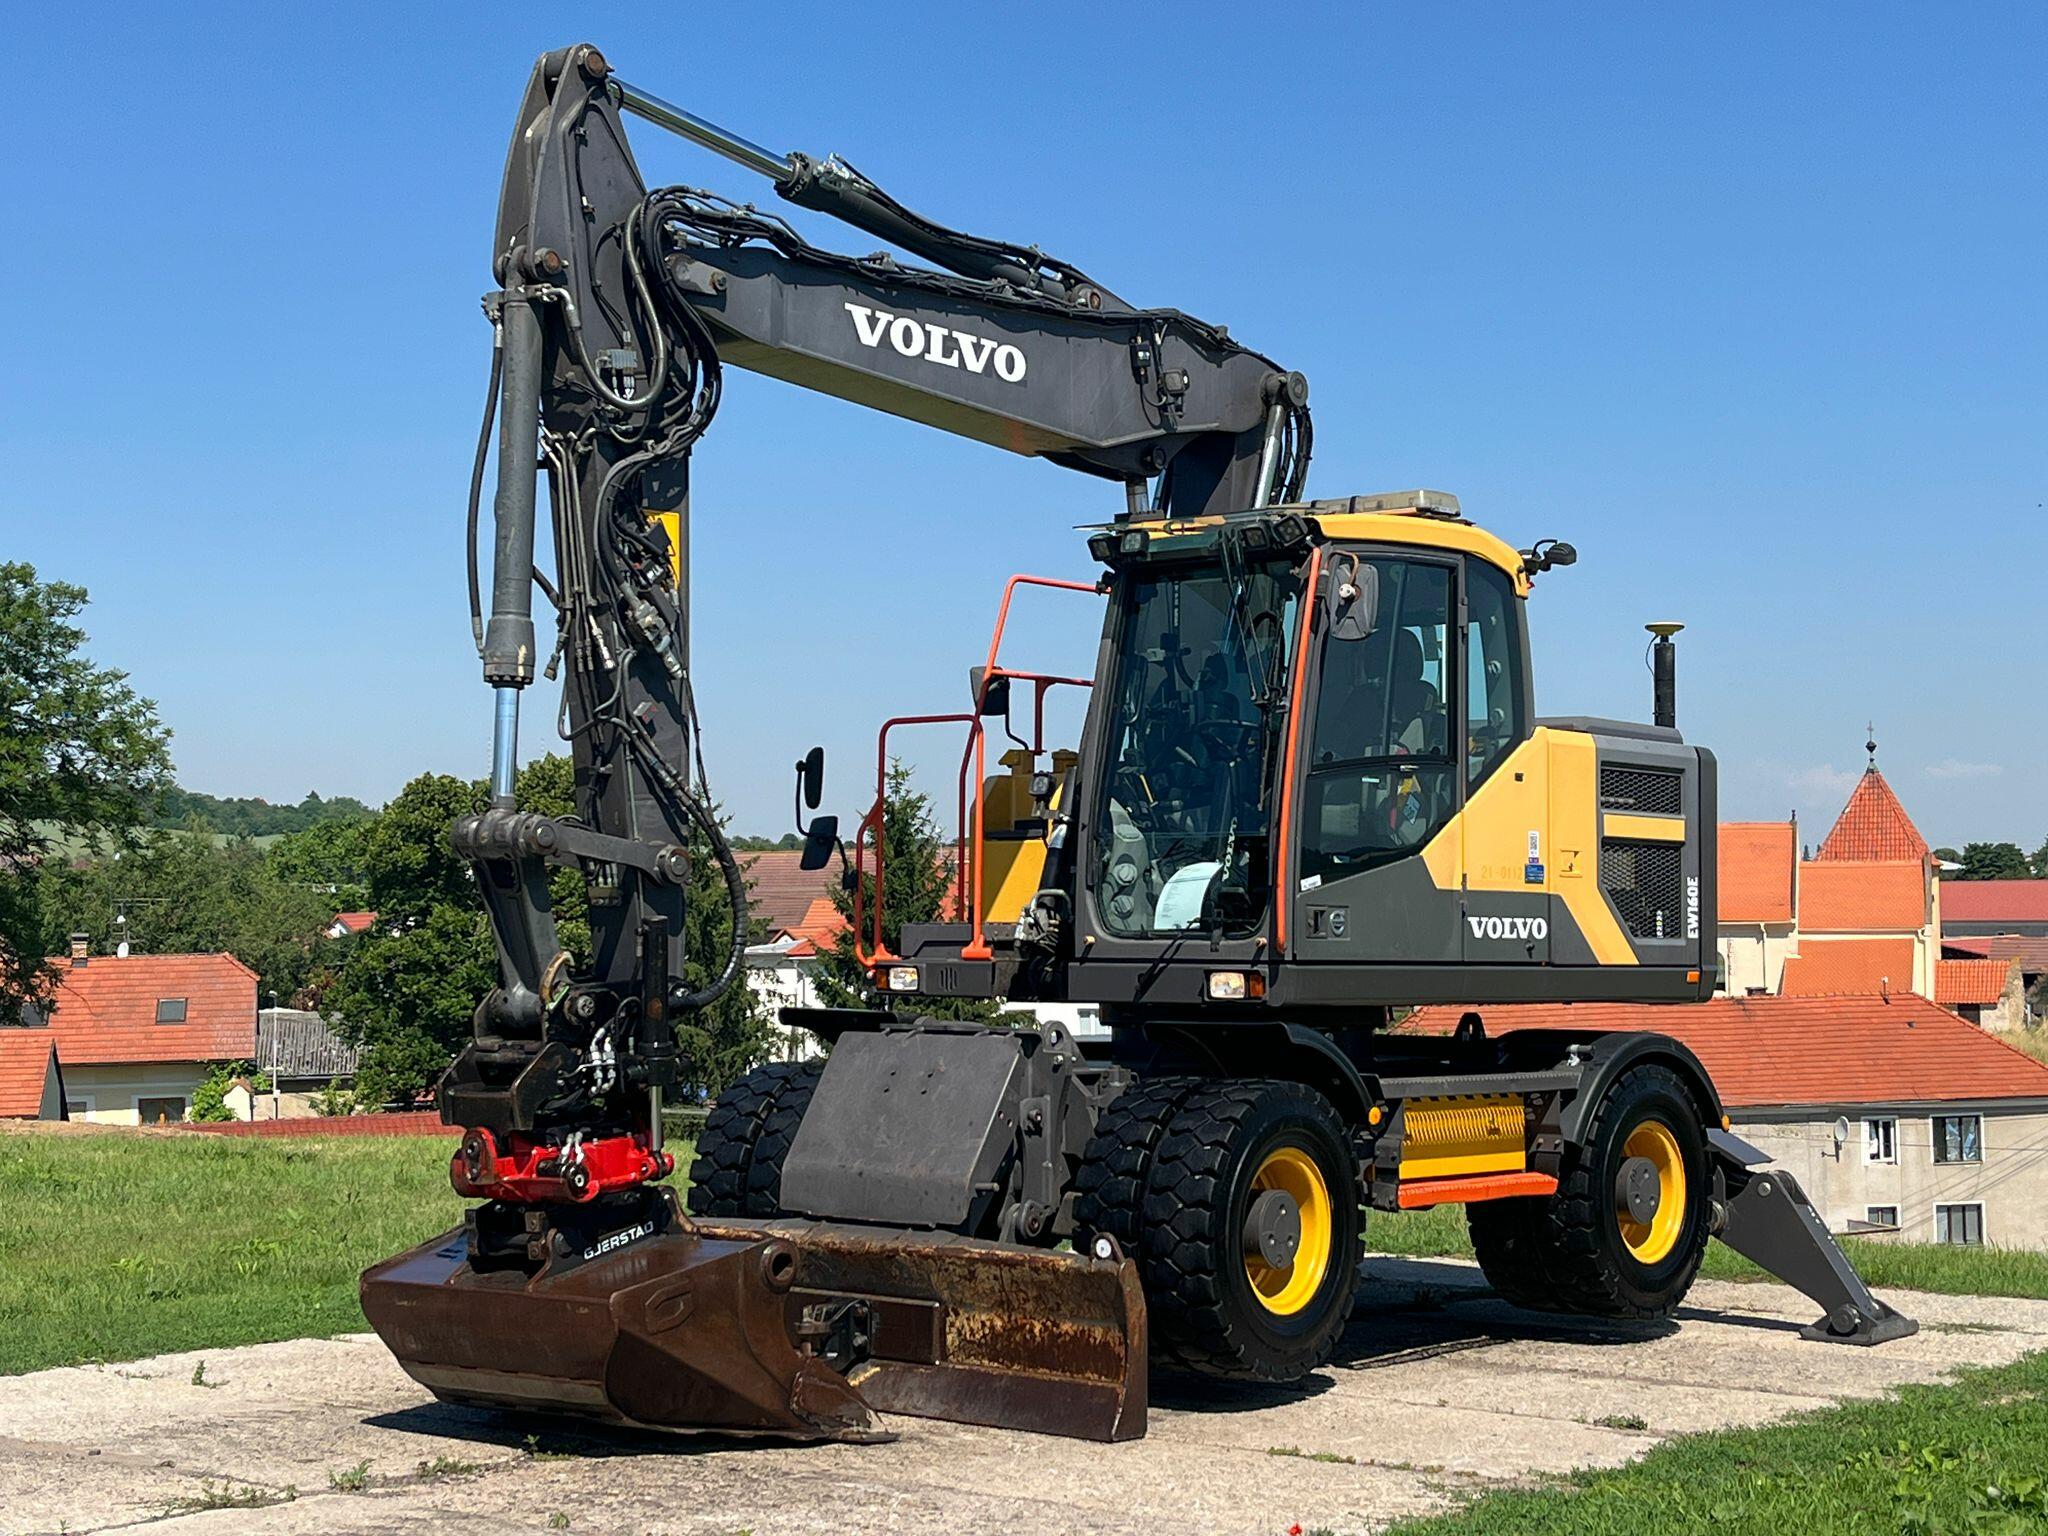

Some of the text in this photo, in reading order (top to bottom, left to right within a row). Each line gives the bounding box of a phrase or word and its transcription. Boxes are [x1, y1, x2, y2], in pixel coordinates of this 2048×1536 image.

[844, 302, 1027, 383] VOLVO
[1222, 816, 1238, 882] VOLVO
[1467, 916, 1548, 940] VOLVO
[1687, 876, 1699, 939] EW160E
[583, 1221, 654, 1260] GJERSTAD
